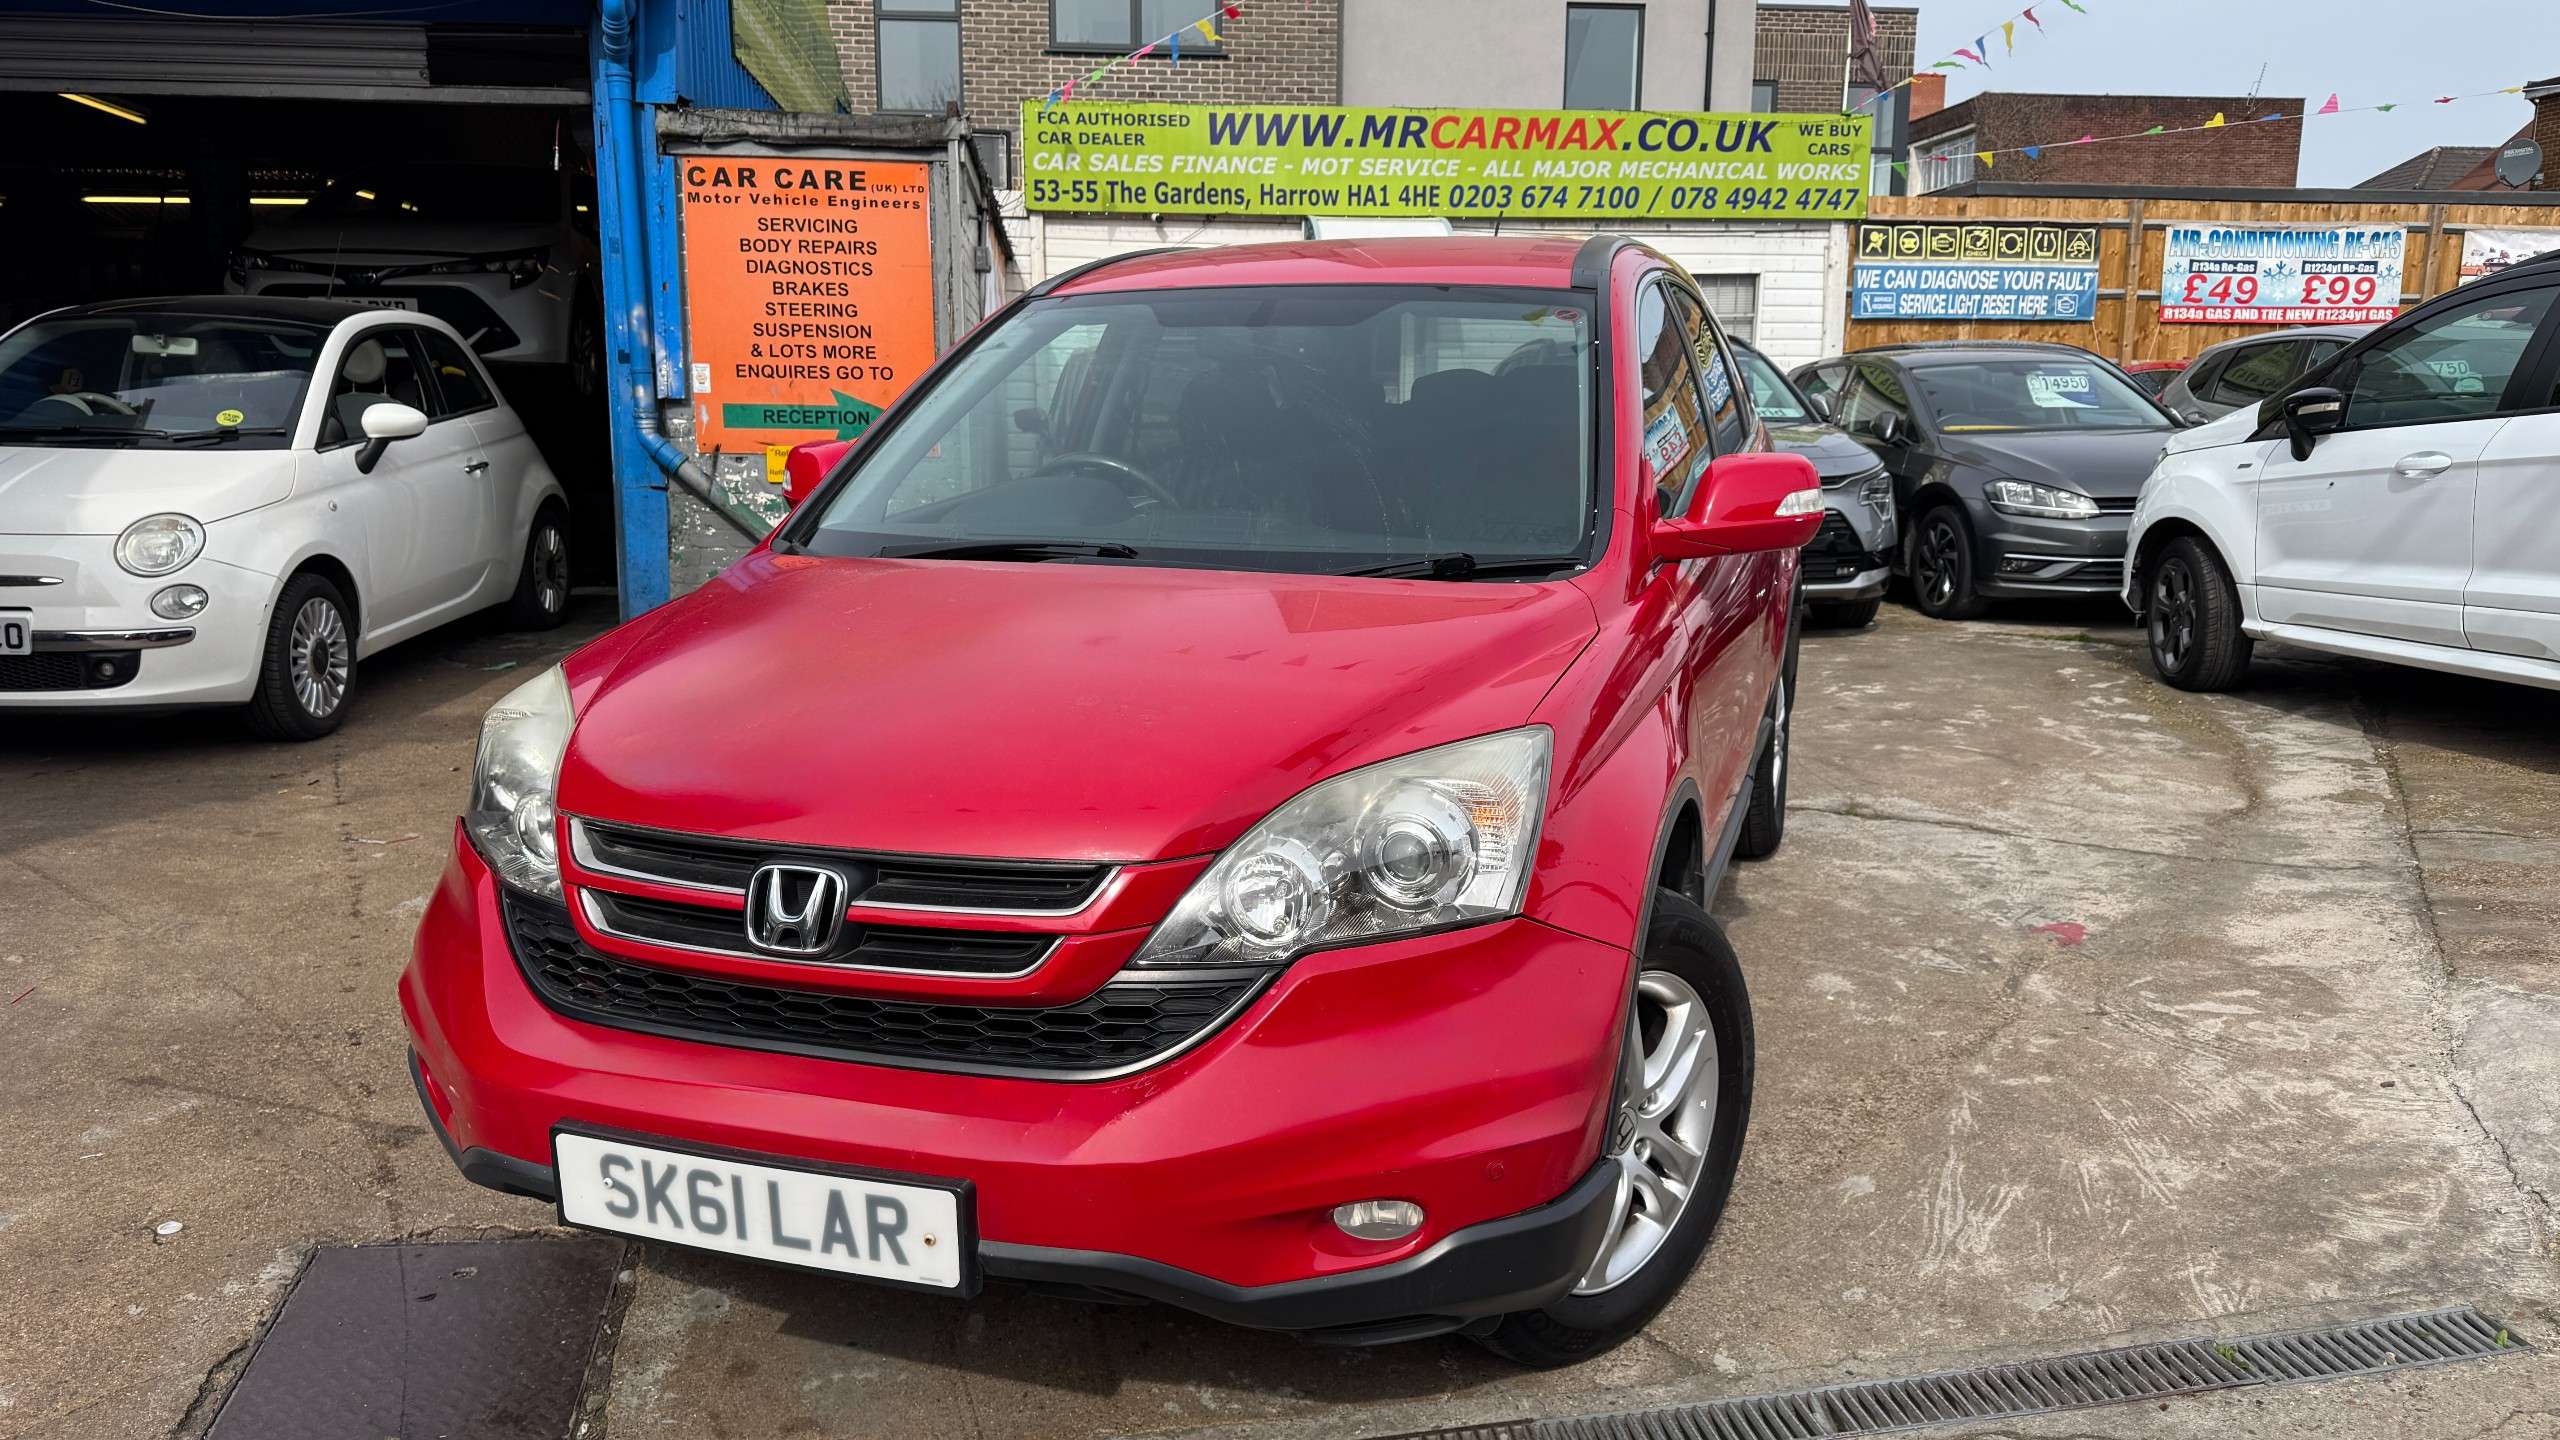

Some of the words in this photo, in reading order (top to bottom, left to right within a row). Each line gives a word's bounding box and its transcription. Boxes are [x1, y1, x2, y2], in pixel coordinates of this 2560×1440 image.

[1037, 111, 1072, 125] FCA
[1075, 112, 1191, 127] AUTHORISED
[1037, 131, 1075, 145] CAR
[1078, 132, 1145, 146] DEALER
[1207, 112, 1780, 152] WWW.MRCARMAX.CO.UK
[1799, 123, 1826, 137] WE
[1829, 124, 1863, 138] BUY
[1808, 142, 1851, 156] CARS
[1032, 152, 1082, 171] CAR
[1088, 153, 1163, 173] SALES
[1170, 155, 1276, 175] FINANCE
[1300, 157, 1352, 176] MOT
[1358, 159, 1459, 178] SERVICE
[1482, 160, 1524, 178] ALL
[1530, 160, 1611, 179] MAJOR
[1618, 161, 1768, 180] MECHANICAL
[1776, 163, 1862, 181] WORKS
[687, 166, 757, 188] CAR
[774, 168, 867, 191] CARE
[871, 184, 897, 194] (UK)
[902, 185, 925, 194] LTD
[688, 192, 741, 204] Motor
[750, 193, 819, 207] Vehicle
[828, 195, 921, 211] Engineers
[1033, 179, 1098, 203] 53-55
[1106, 180, 1147, 204] The
[1154, 181, 1251, 210] Gardens,
[1260, 183, 1339, 208] Harrow
[1348, 184, 1389, 208] HA1
[1399, 185, 1440, 208] 4HE
[1449, 184, 1513, 209] 0203
[1520, 185, 1568, 209] 674
[1577, 185, 1640, 210] 7100
[1671, 186, 1717, 210] 078
[1725, 187, 1786, 210] 4942
[1795, 188, 1860, 211] 4747
[757, 217, 858, 234] SERVICING
[739, 238, 791, 253] BODY
[798, 239, 877, 256] REPAIRS
[2169, 229, 2339, 259] AIR-CONDITIONING
[2343, 231, 2402, 260] RE-GAS
[746, 260, 873, 277] DIAGNOSTICS
[772, 281, 849, 297] BRAKES
[1857, 269, 1881, 289] WE
[1884, 269, 1918, 289] CAN
[1920, 270, 1998, 290] DIAGNOSE
[2003, 271, 2045, 291] YOUR
[2047, 271, 2094, 291] FAULT
[2182, 273, 2258, 305] £49
[2300, 275, 2377, 305] £99
[765, 302, 858, 318] STEERING
[1899, 293, 1945, 314] SERVICE
[1948, 294, 1981, 314] LIGHT
[1983, 294, 2016, 315] RESET
[2018, 295, 2048, 315] HERE
[2164, 308, 2204, 319] R134a
[2206, 308, 2231, 319] GAS
[2233, 309, 2258, 320] AND
[2261, 309, 2283, 320] THE
[2286, 309, 2314, 320] NEW
[2317, 309, 2369, 321] R1234yf
[2370, 310, 2393, 321] GAS
[753, 323, 872, 339] SUSPENSION
[751, 344, 763, 358] &
[769, 344, 817, 359] LOTS
[823, 345, 877, 360] MORE
[736, 364, 830, 380] ENQUIRES
[836, 365, 864, 381] GO
[869, 366, 894, 381] TO
[763, 408, 870, 426] RECEPTION
[599, 1152, 748, 1242] SK61
[766, 1179, 911, 1267] LAR
